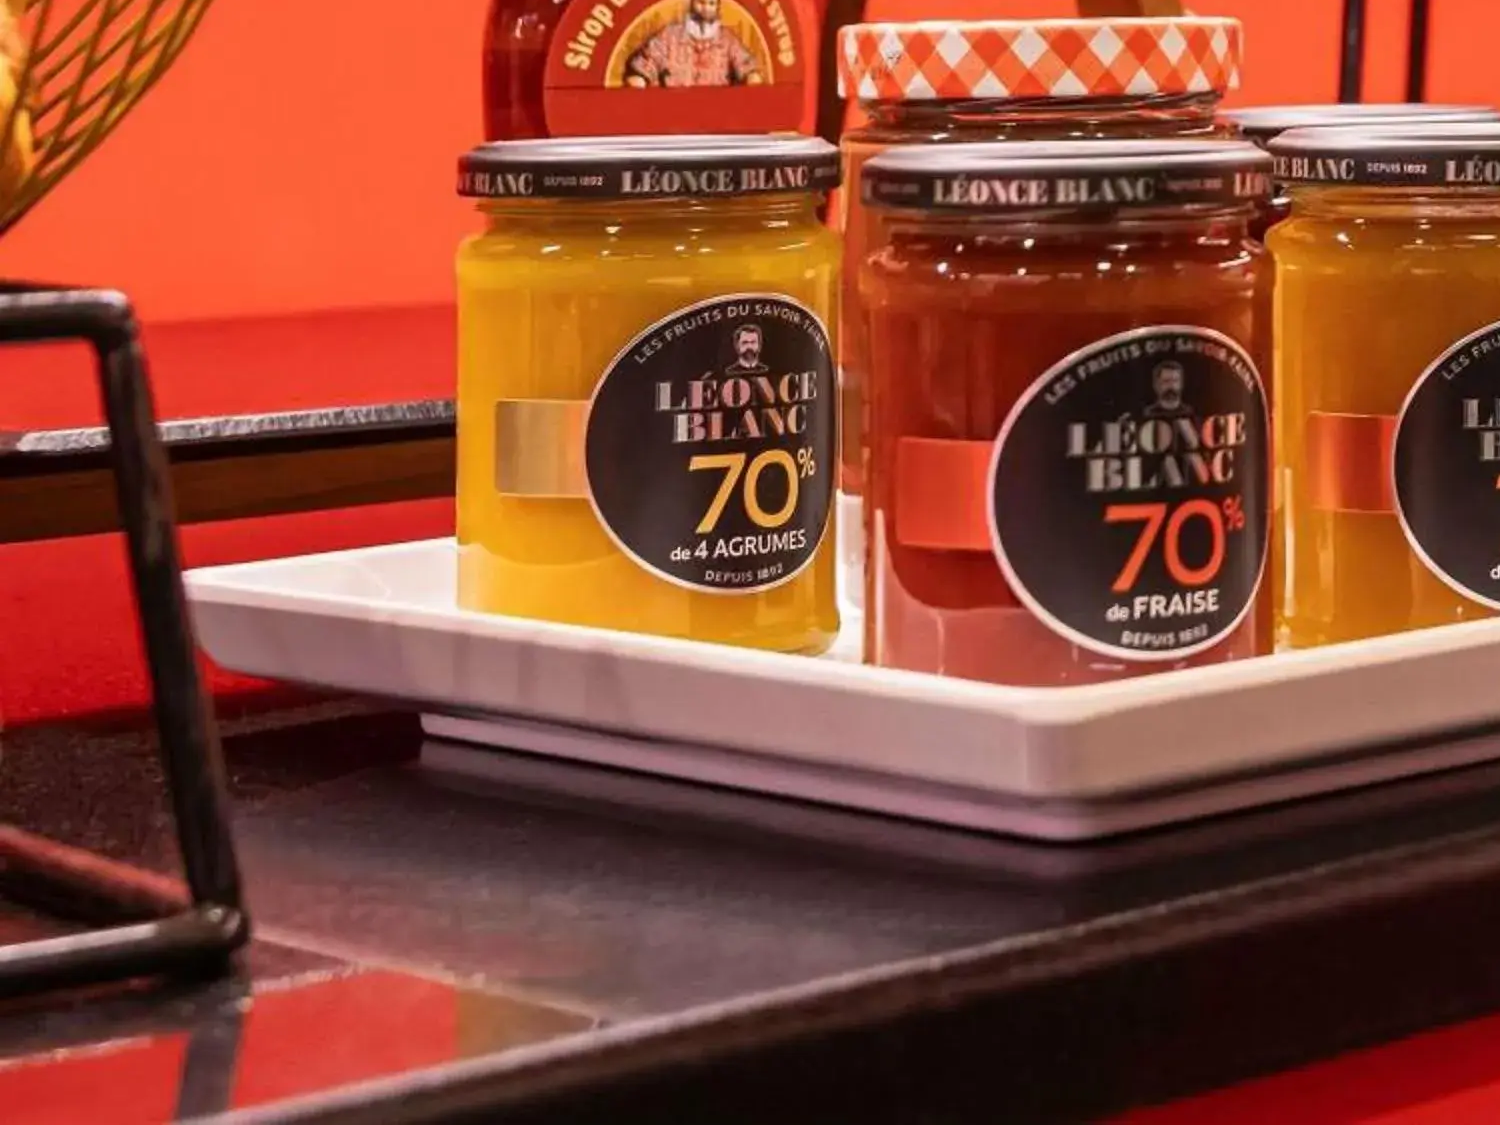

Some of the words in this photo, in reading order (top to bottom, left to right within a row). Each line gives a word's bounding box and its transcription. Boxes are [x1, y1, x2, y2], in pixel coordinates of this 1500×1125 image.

[564, 4, 615, 71] Sirop
[620, 166, 734, 194] LÉONCE
[741, 166, 808, 191] BLANC
[1292, 157, 1354, 180] BLANC
[932, 174, 1048, 205] LÉONCE
[1055, 177, 1156, 204] BLANC
[634, 339, 663, 364] LES
[665, 309, 722, 343] FRUITS
[727, 304, 750, 318] DU
[1043, 374, 1075, 405] LES
[1077, 344, 1141, 379] FRUITS
[1442, 355, 1469, 381] LES
[655, 371, 818, 411] LÉONCE
[672, 404, 807, 443] BLANC
[1066, 412, 1246, 457] LÉONCE
[1087, 449, 1235, 493] BLANC
[670, 547, 692, 562] de
[694, 540, 709, 560] 4
[713, 528, 807, 558] AGRUMES
[705, 570, 753, 583] DEPUIS
[1106, 603, 1129, 622] de
[1133, 588, 1220, 620] FRAISE
[1120, 631, 1175, 647] DEPUIS
